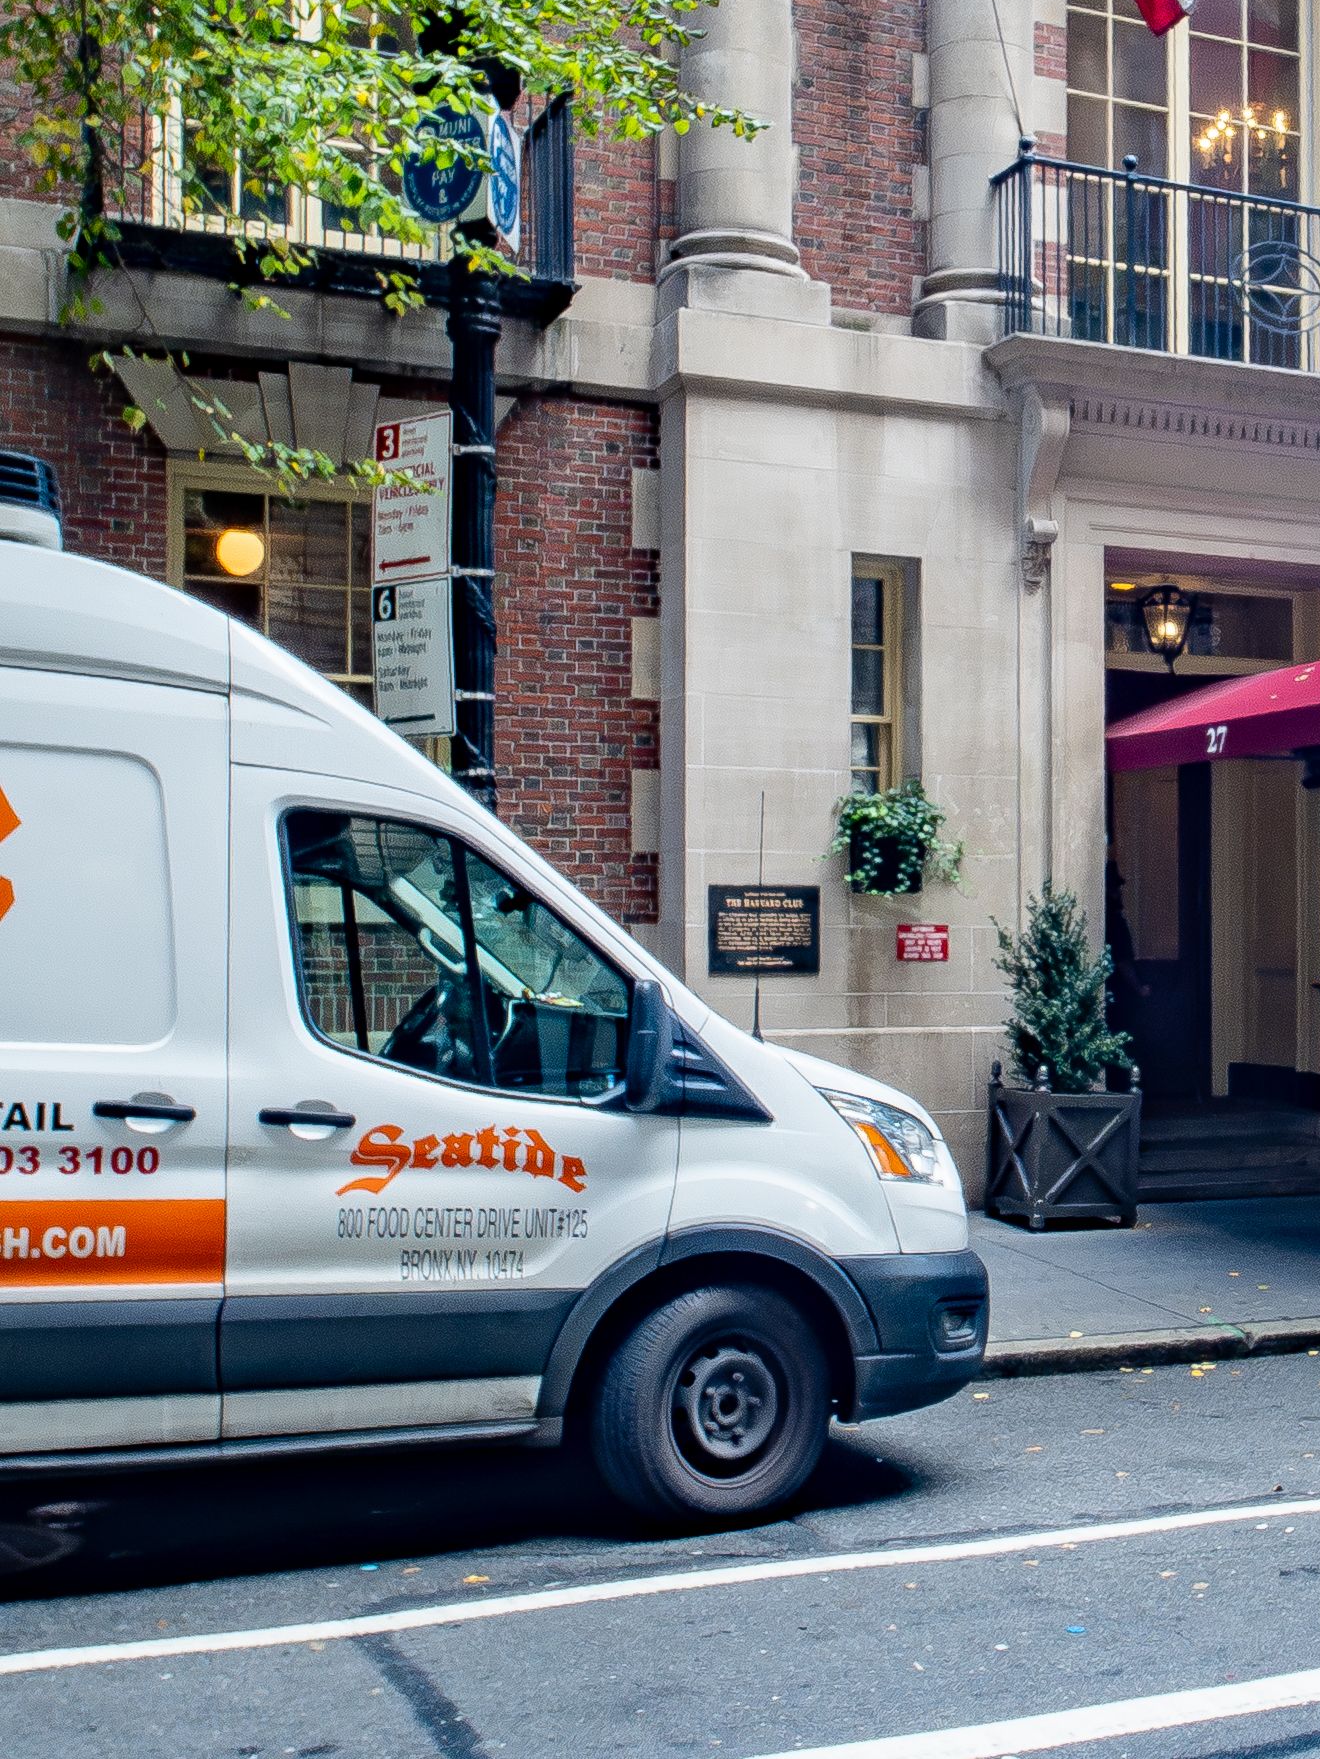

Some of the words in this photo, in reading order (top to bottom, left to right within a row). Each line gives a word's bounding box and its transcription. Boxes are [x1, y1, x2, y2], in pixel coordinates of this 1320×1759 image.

[382, 428, 395, 458] 3
[378, 589, 392, 620] 6
[1206, 725, 1227, 754] 27
[0, 1102, 75, 1132] AIL
[58, 1145, 160, 1175] 3100
[335, 1123, 588, 1197] Seatide
[337, 1208, 364, 1239] 800
[367, 1208, 410, 1239] FOOD
[414, 1208, 474, 1239] CENTER
[477, 1208, 521, 1238] DRIVE
